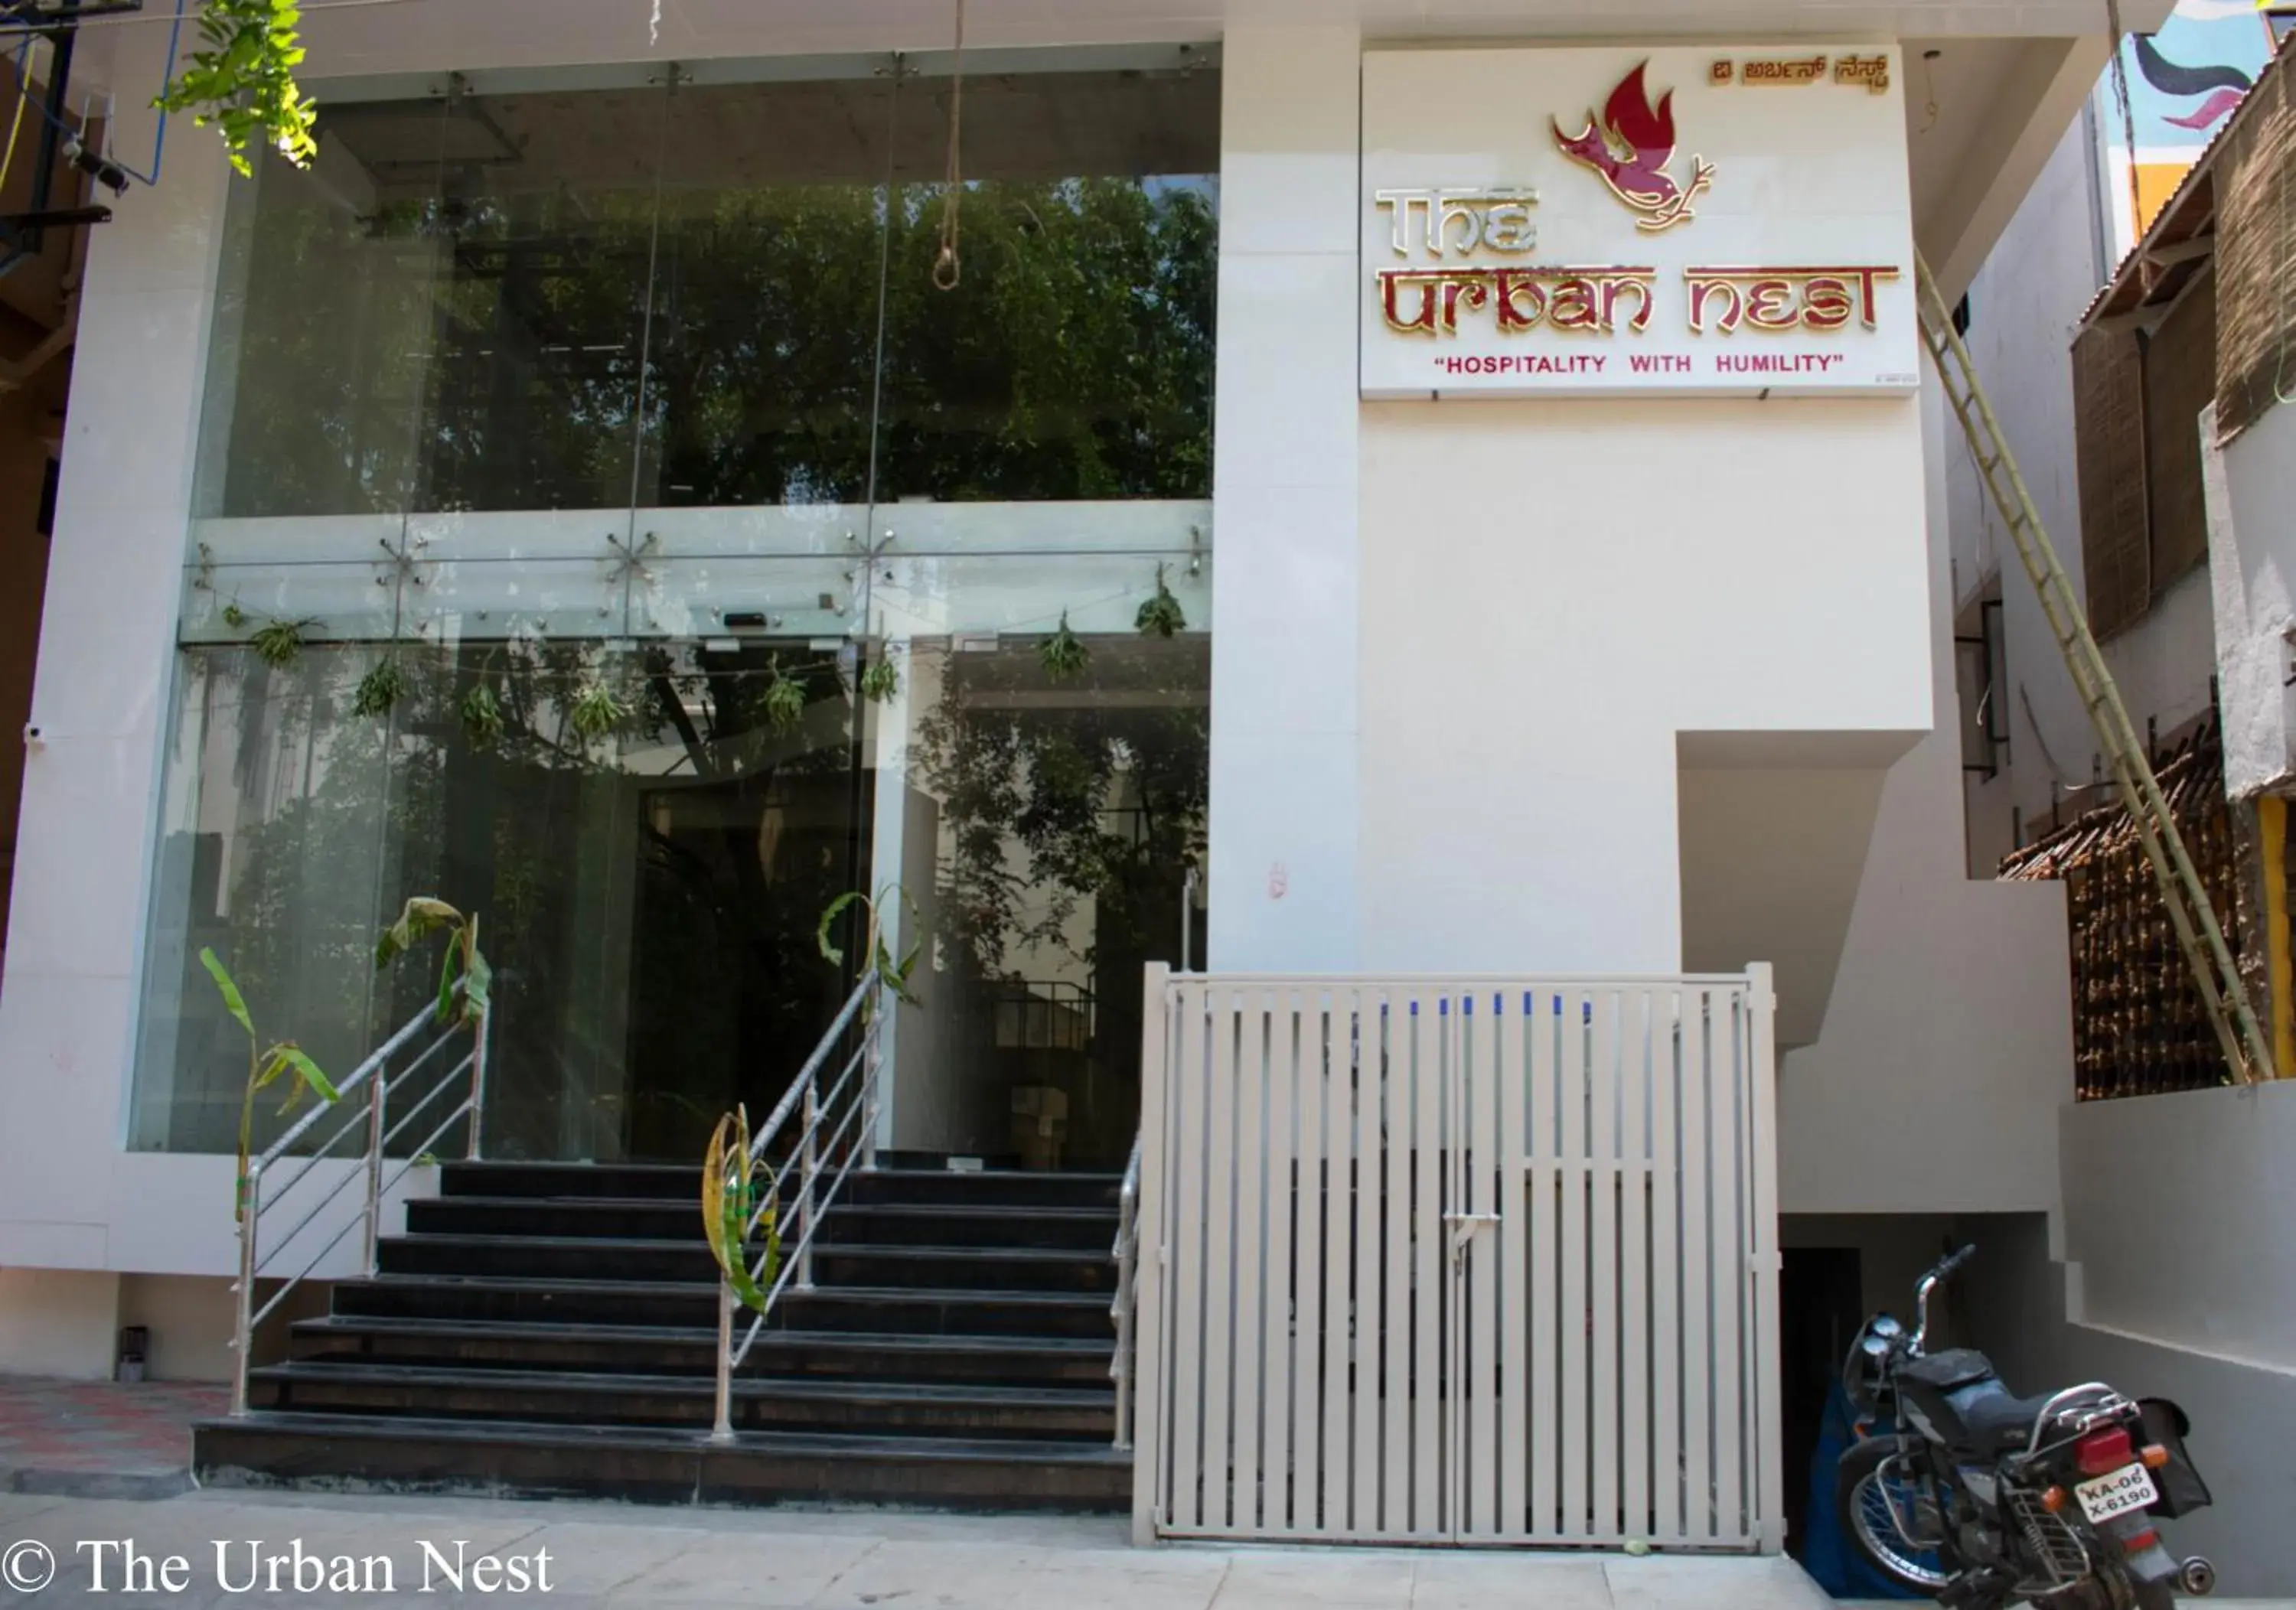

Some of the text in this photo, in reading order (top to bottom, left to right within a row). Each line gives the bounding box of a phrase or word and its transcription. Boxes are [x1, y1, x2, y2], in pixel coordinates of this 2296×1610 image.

[1630, 355, 1691, 373] WITH
[2085, 1471, 2144, 1501] KA-06
[2089, 1488, 2151, 1517] X-6190
